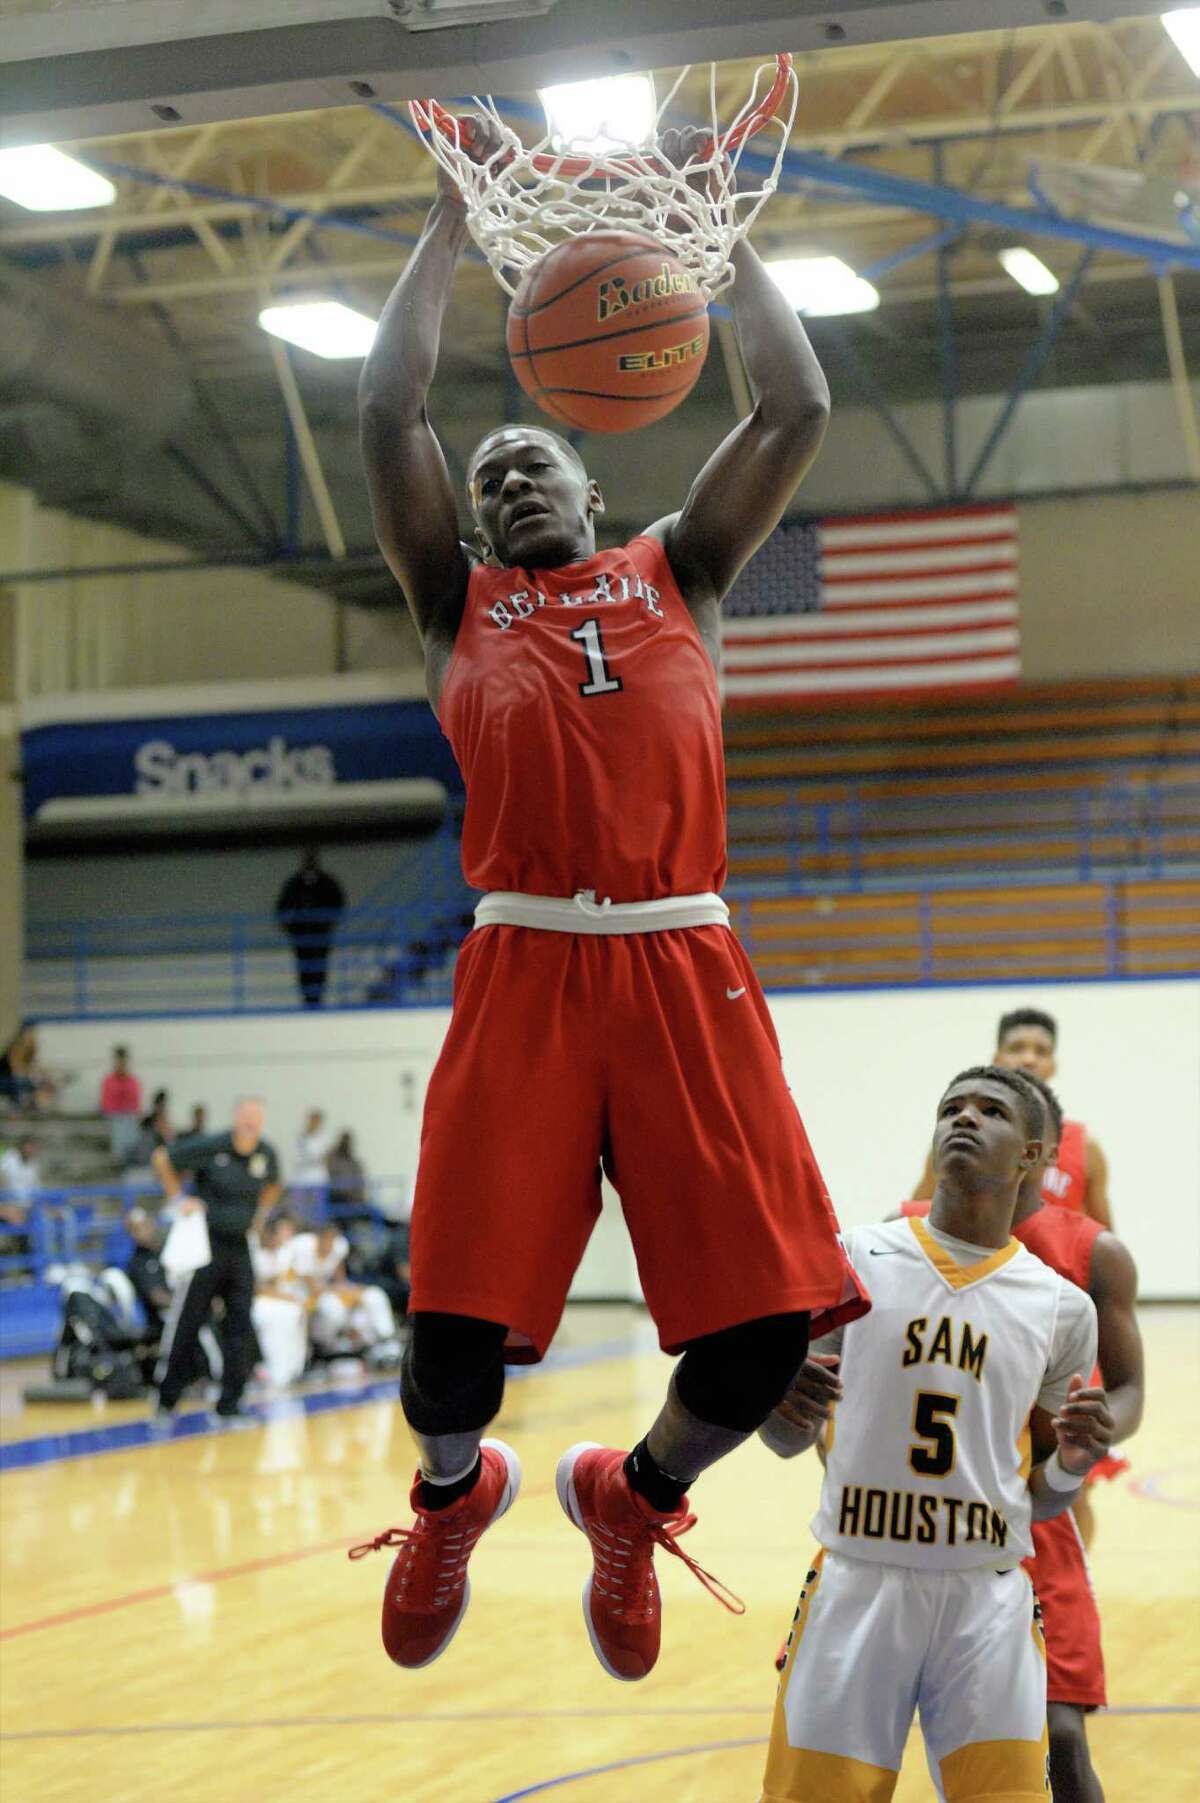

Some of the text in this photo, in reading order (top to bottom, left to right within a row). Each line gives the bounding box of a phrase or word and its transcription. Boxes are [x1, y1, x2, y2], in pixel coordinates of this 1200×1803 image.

[616, 332, 705, 373] ELITE
[570, 618, 624, 698] 1
[134, 736, 336, 800] Snacks
[902, 1315, 990, 1384] SAM
[907, 1388, 962, 1479] 5
[837, 1484, 1010, 1549] HOUSTON
